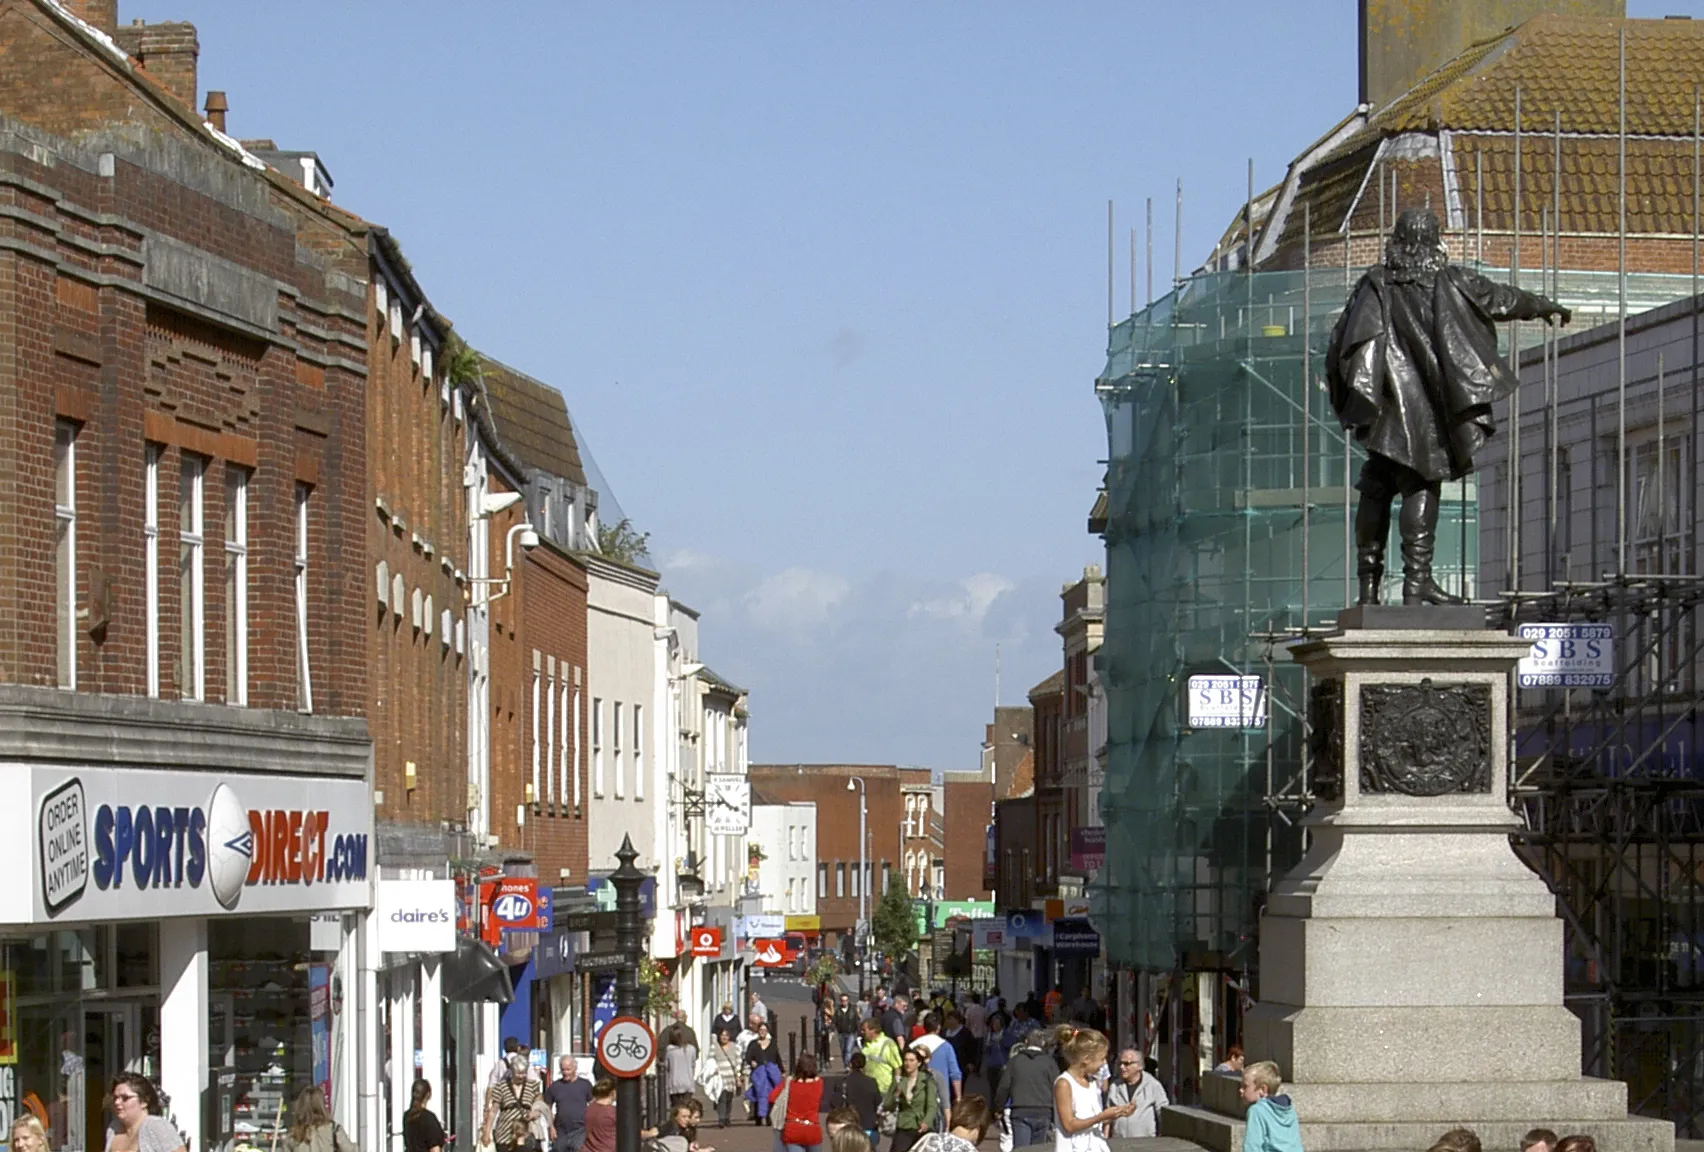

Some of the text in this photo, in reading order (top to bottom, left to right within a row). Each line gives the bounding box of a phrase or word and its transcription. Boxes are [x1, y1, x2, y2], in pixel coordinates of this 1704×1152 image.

[1523, 628, 1611, 638] 029 2051 5879
[1534, 660, 1601, 668] Scaffolding
[1523, 675, 1611, 685] 07889 832975
[47, 793, 78, 831] ORDER
[48, 823, 81, 862] ONLINE
[93, 804, 206, 890] SPORTS
[48, 852, 86, 896] ANYTIME
[391, 908, 449, 923] claire's
